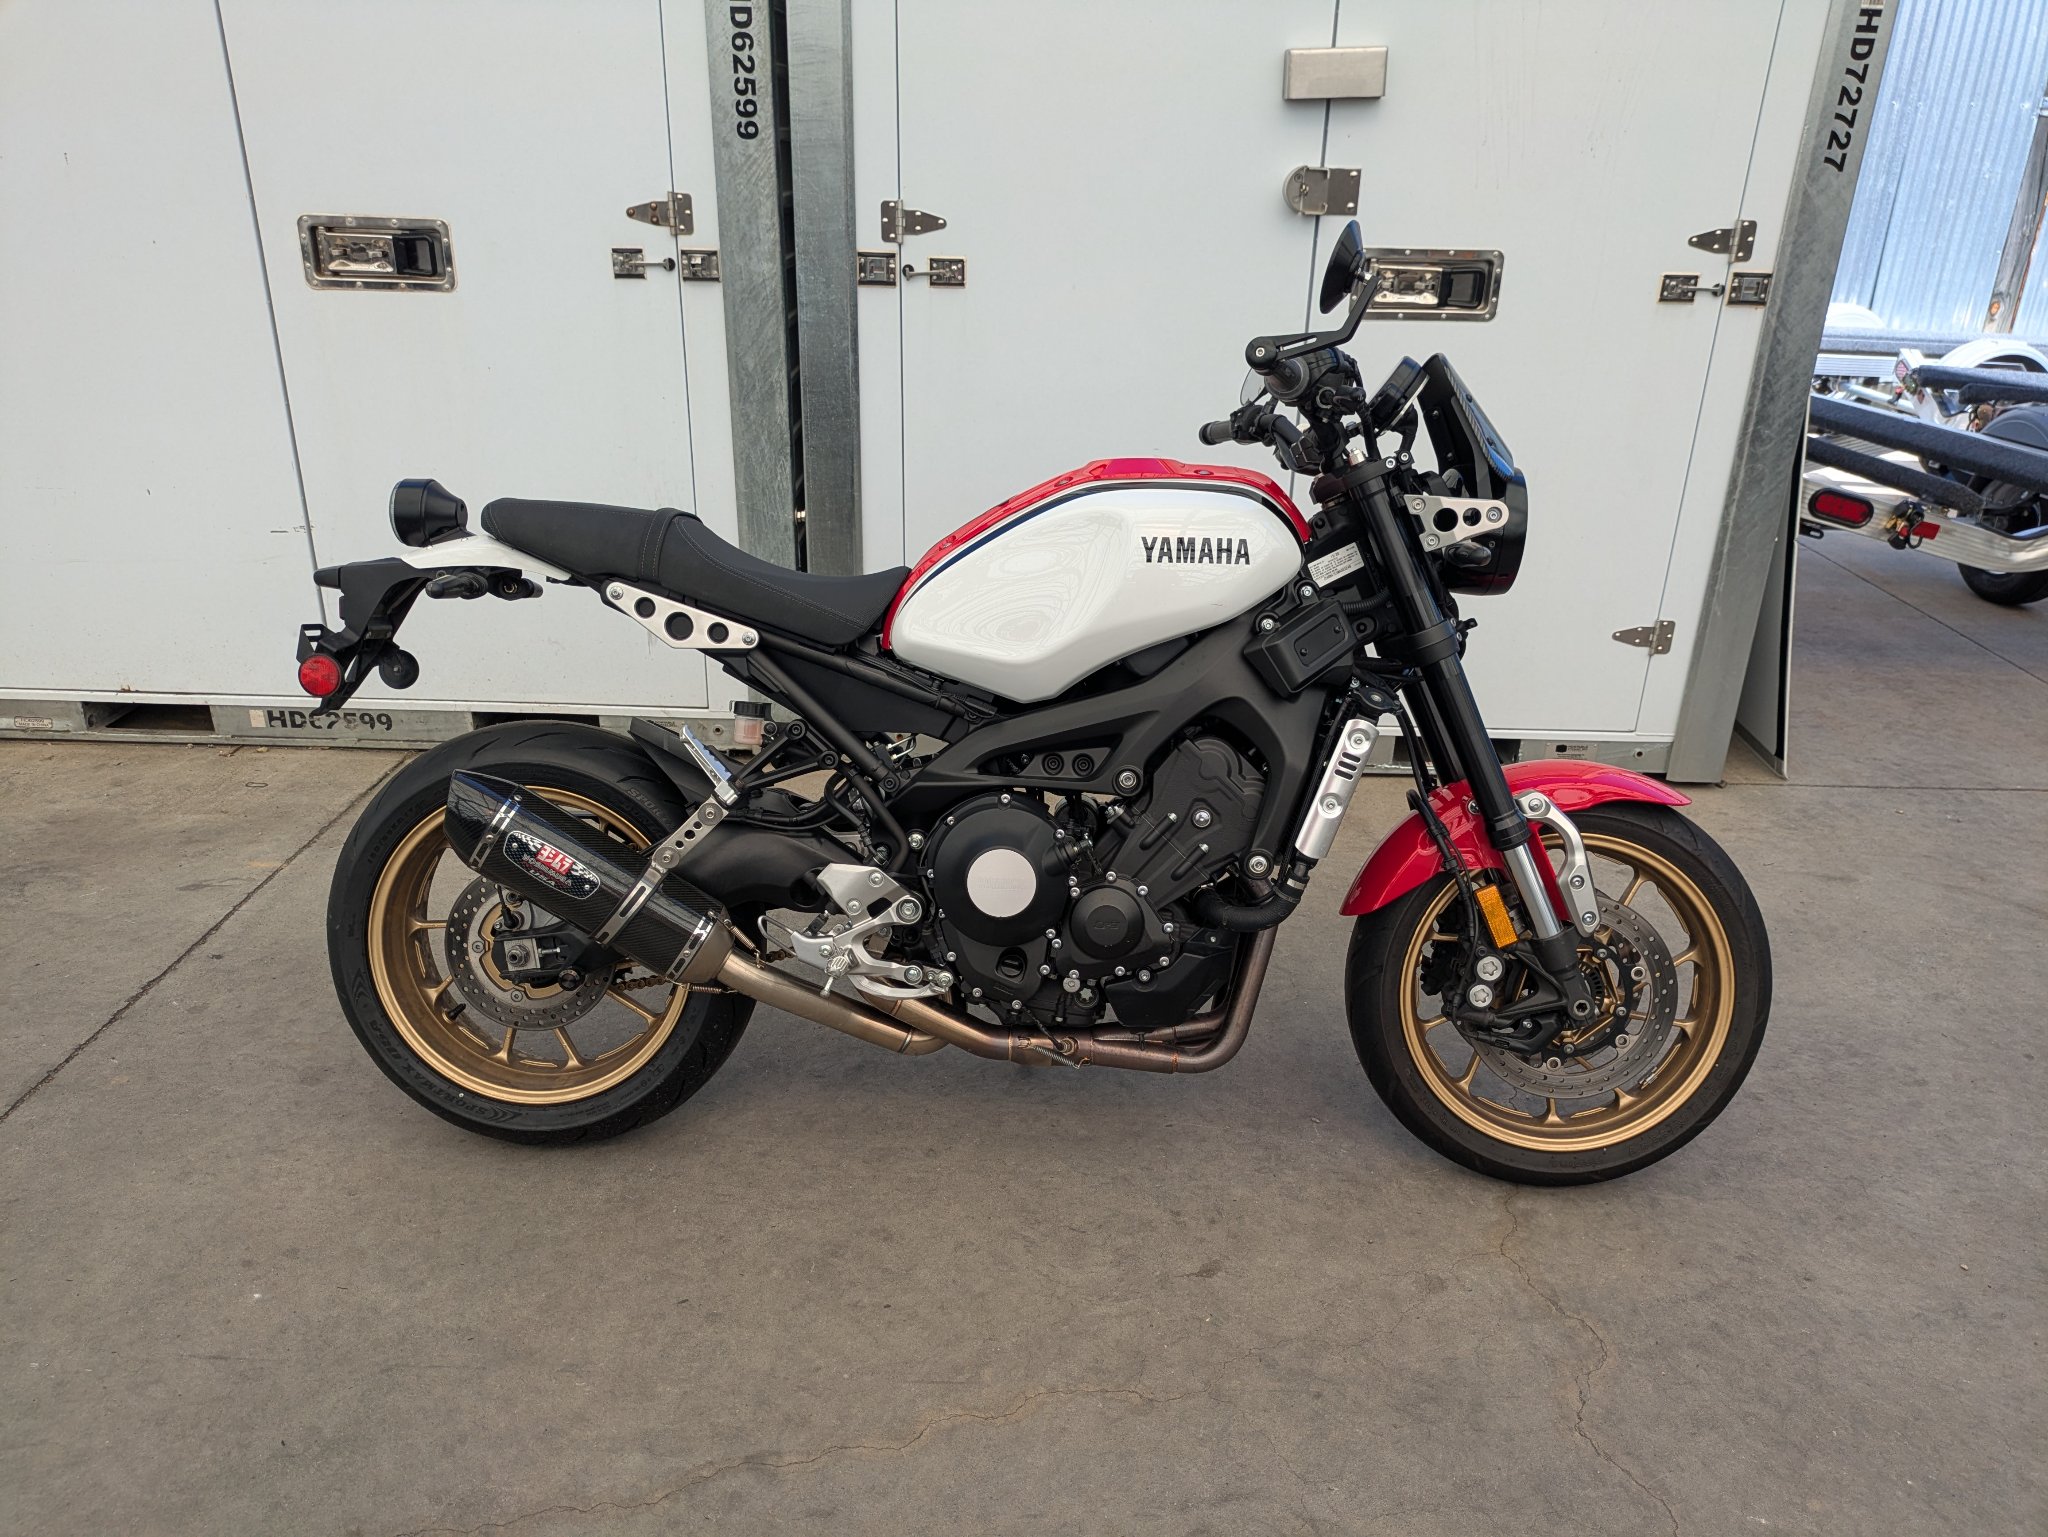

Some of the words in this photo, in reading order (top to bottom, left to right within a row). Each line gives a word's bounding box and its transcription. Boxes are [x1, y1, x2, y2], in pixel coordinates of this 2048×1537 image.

[729, 0, 759, 140] D62599
[1823, 8, 1883, 173] HD72727
[1141, 536, 1250, 565] YAMAHA
